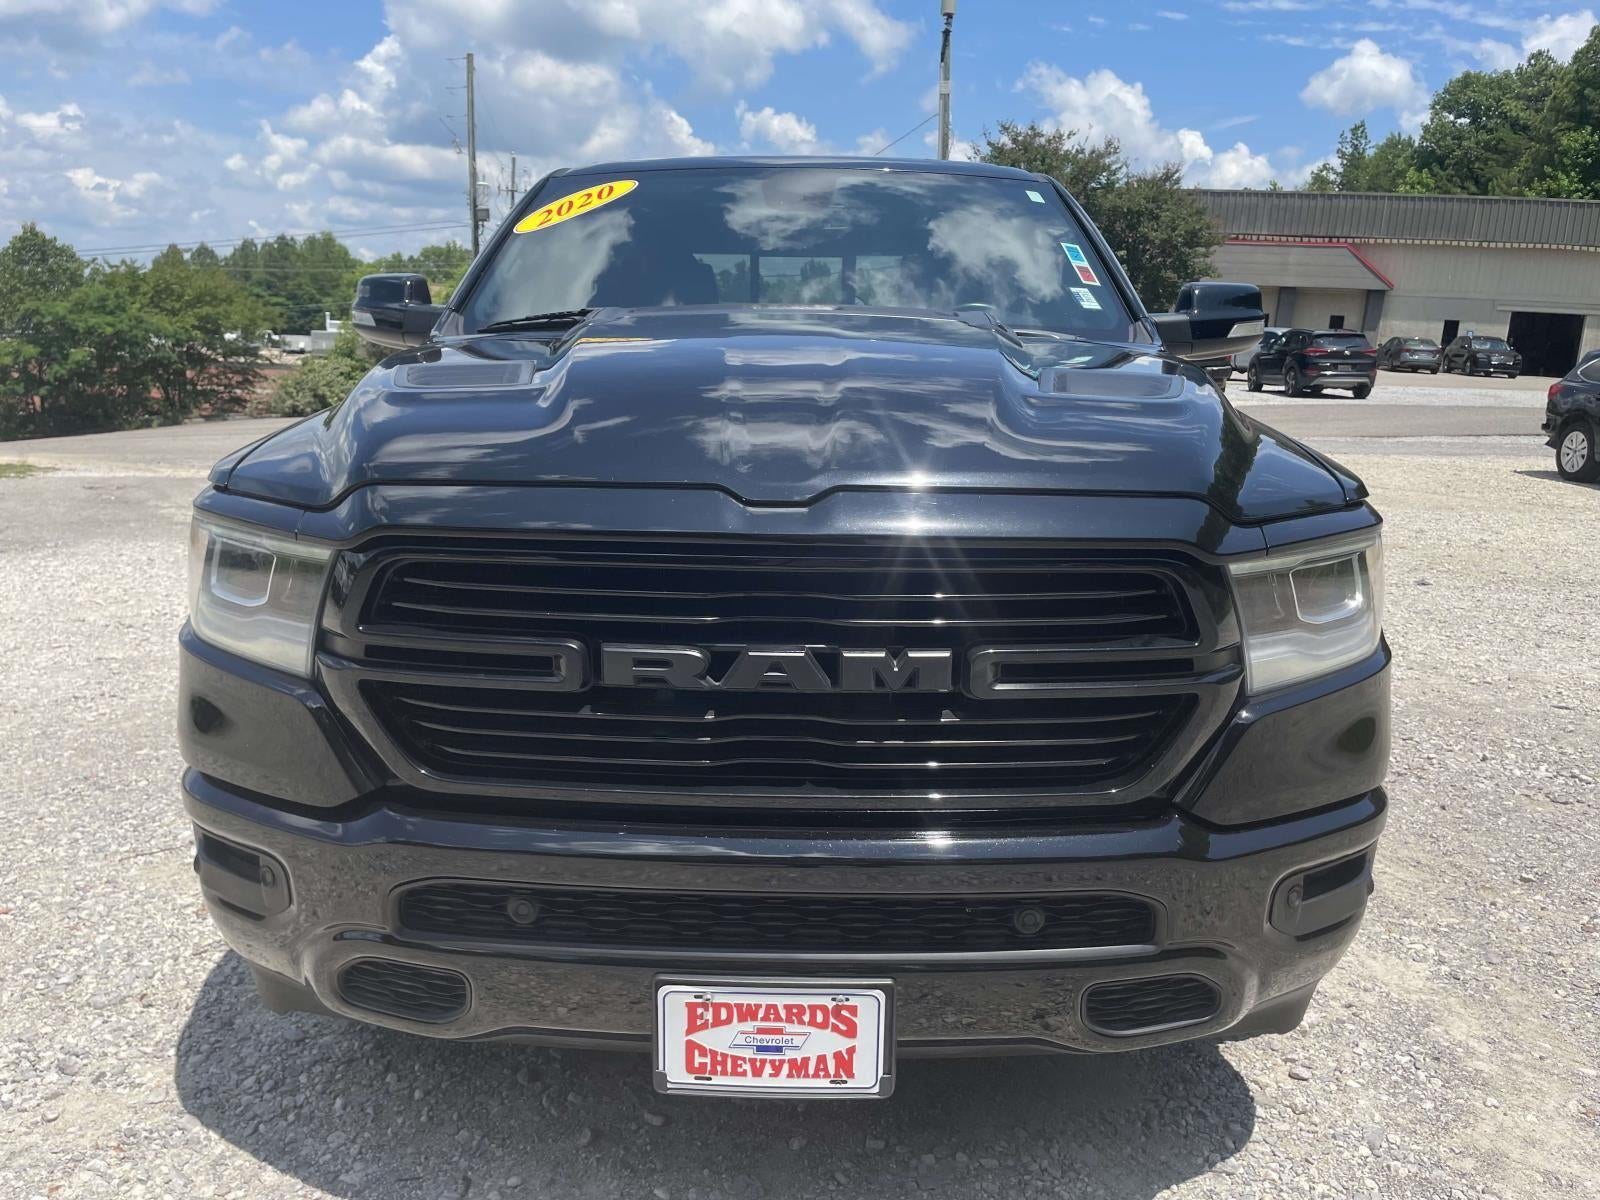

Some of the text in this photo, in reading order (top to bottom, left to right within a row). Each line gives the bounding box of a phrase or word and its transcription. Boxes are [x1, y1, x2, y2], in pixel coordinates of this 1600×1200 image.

[536, 185, 615, 227] 2020
[602, 642, 952, 693] RAM
[684, 1001, 858, 1039] EDWARDS
[744, 1035, 795, 1046] Chevrolet
[684, 1037, 857, 1080] CHEVYMAN
